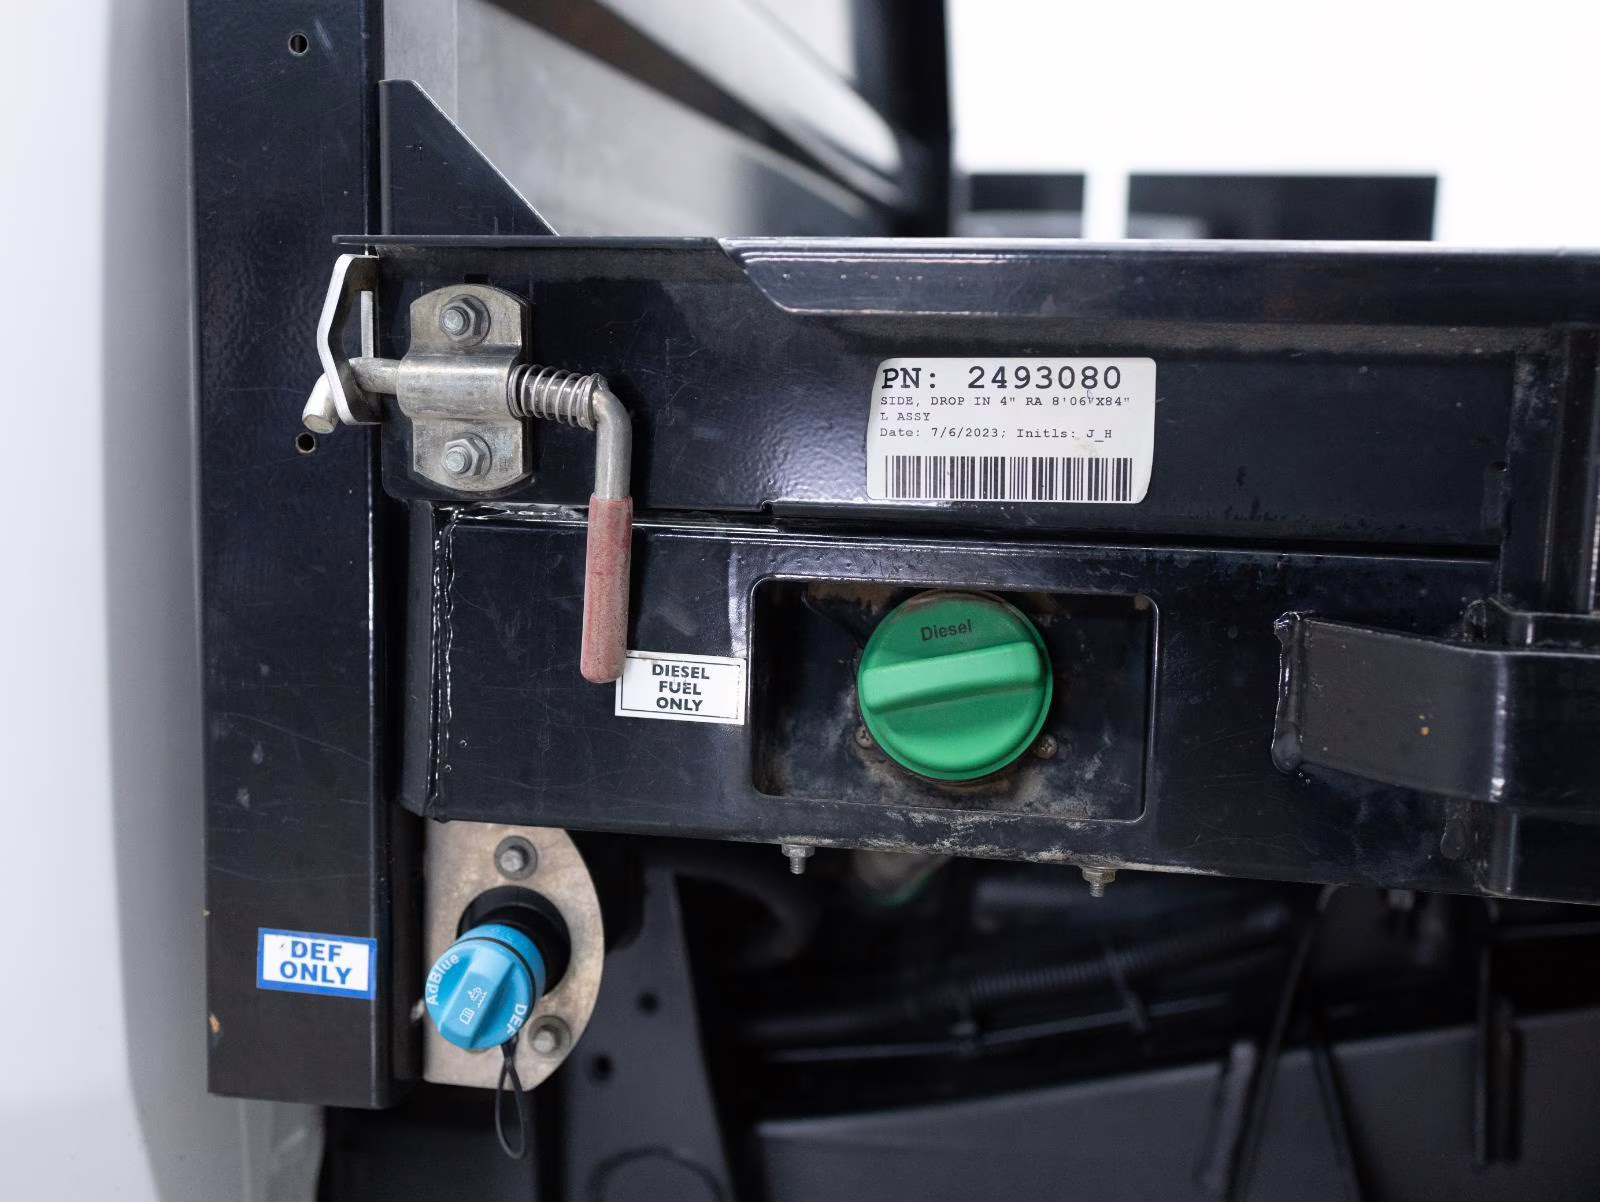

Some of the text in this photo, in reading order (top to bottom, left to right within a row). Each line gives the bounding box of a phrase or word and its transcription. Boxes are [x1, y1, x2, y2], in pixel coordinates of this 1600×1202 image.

[881, 365, 1122, 390] PN: 2493080
[880, 396, 920, 408] SIDE,
[930, 396, 965, 406] DROP
[974, 396, 991, 406] IN
[1000, 396, 1016, 406] 4"
[1025, 396, 1043, 406] RA
[879, 411, 931, 422] L ASSY
[879, 426, 1113, 442] Date: 7/6/2023; Initls: J_H
[920, 618, 973, 642] Diesel
[651, 663, 710, 680] DIESEL
[658, 680, 702, 696] FUEL
[656, 697, 703, 712] ONLY
[291, 940, 343, 962] DEF
[279, 960, 352, 985] ONLY
[425, 953, 460, 1006] AdBlue
[506, 1003, 528, 1036] DEF
